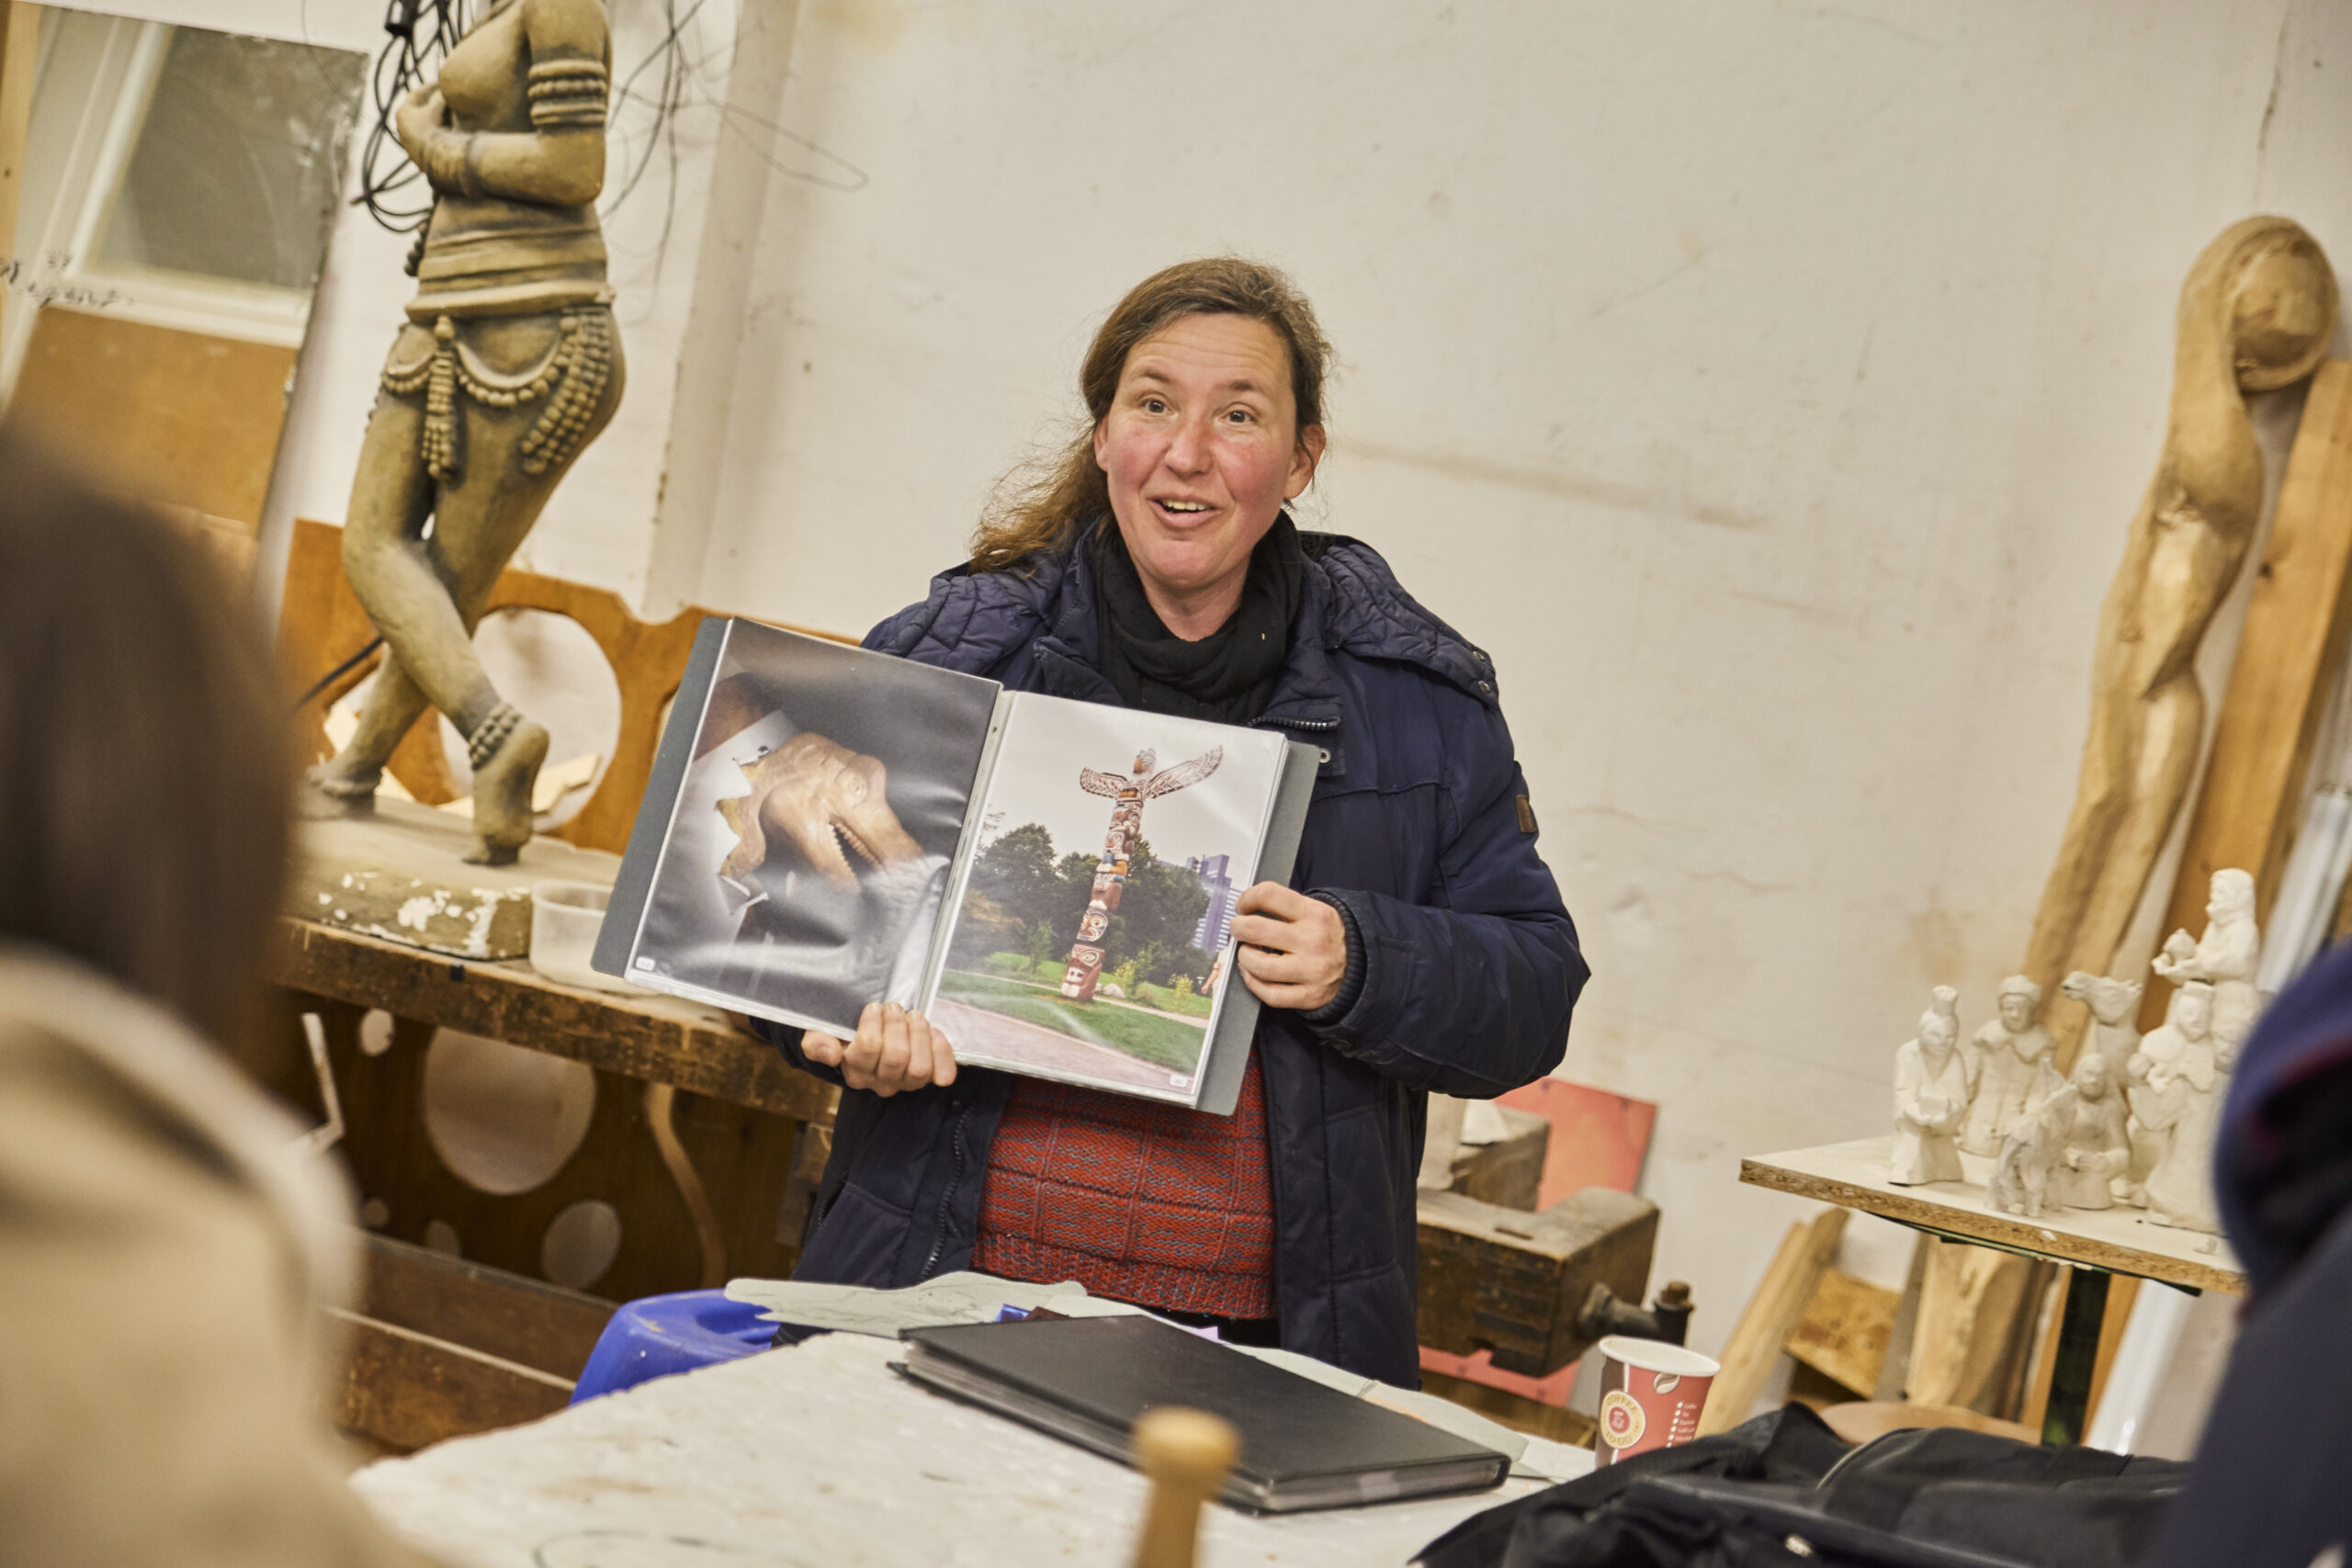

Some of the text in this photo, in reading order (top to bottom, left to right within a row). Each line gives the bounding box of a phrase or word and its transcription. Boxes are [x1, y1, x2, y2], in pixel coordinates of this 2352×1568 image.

[1607, 1393, 1639, 1414] COFFEE
[1605, 1430, 1633, 1447] TO GO
